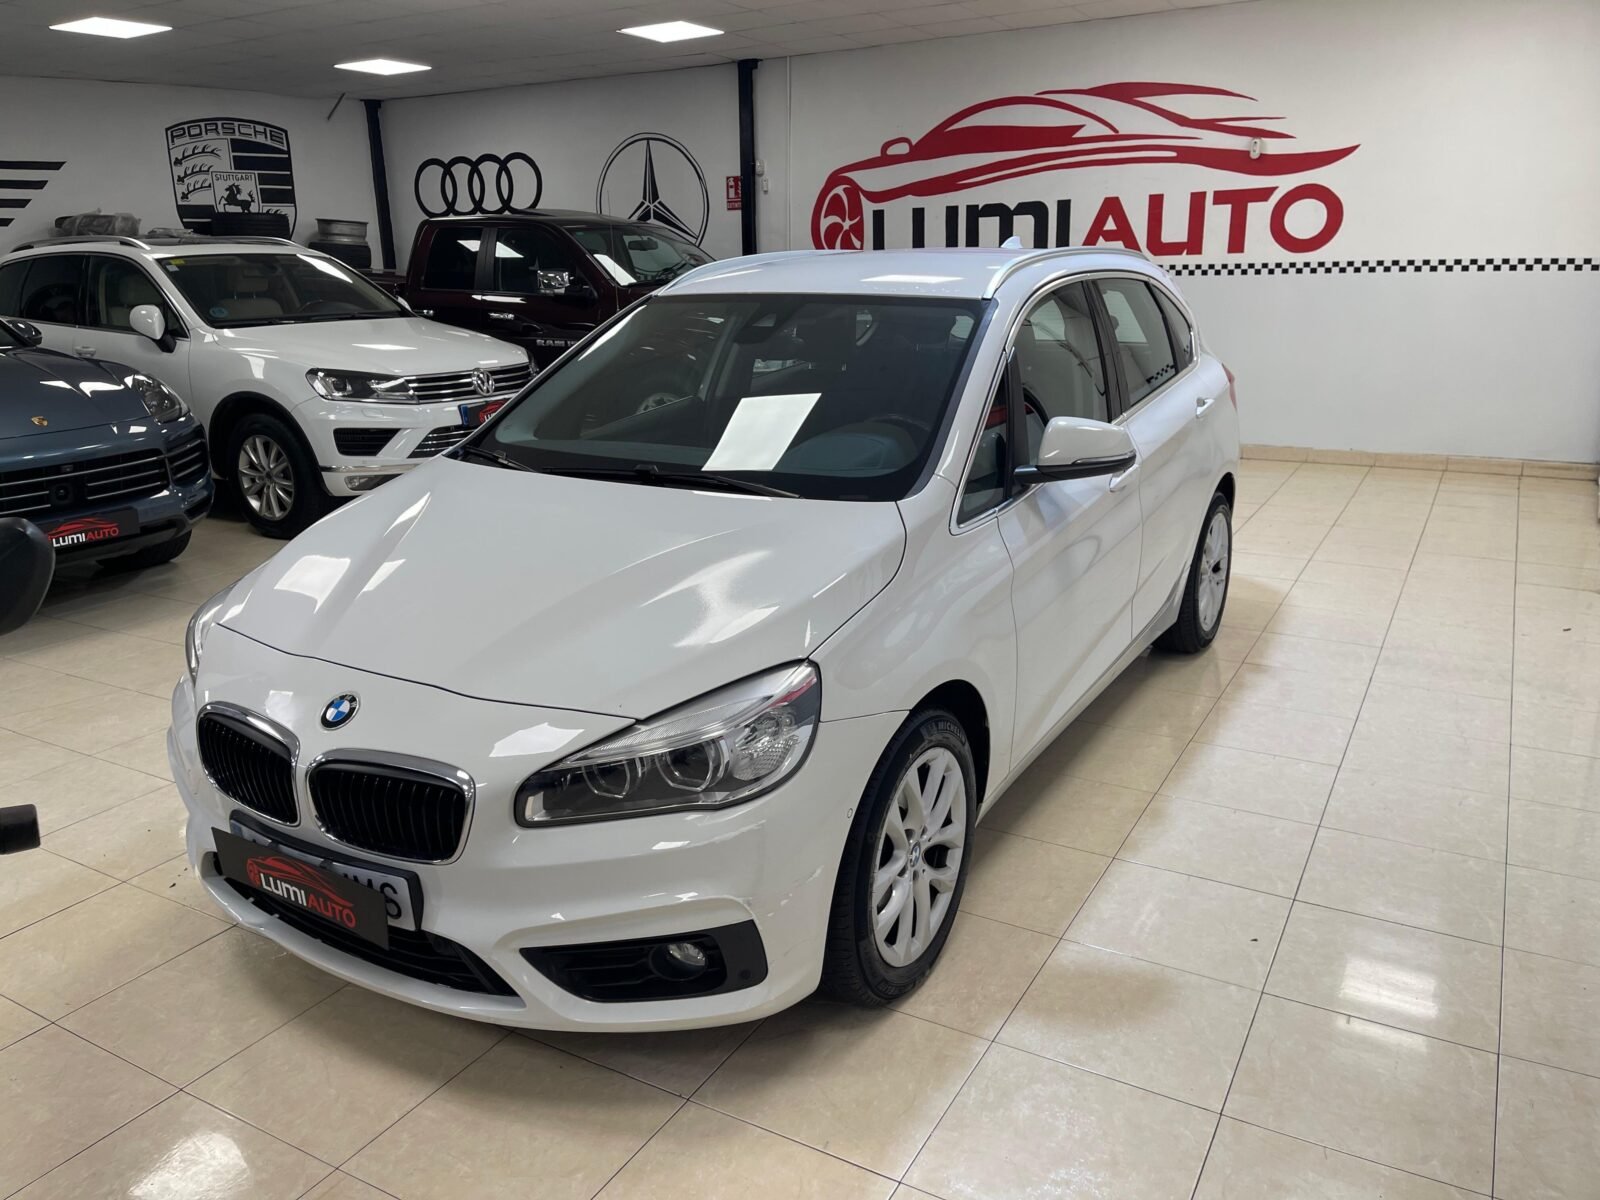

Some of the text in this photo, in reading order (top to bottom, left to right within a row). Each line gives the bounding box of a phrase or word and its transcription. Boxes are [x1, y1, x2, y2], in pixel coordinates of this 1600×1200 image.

[170, 122, 286, 147] PORSCHE
[214, 173, 253, 182] STUTTGART
[536, 339, 565, 347] RAM
[52, 527, 119, 547] LUMIAUTO
[260, 872, 357, 929] LUMIAUTO
